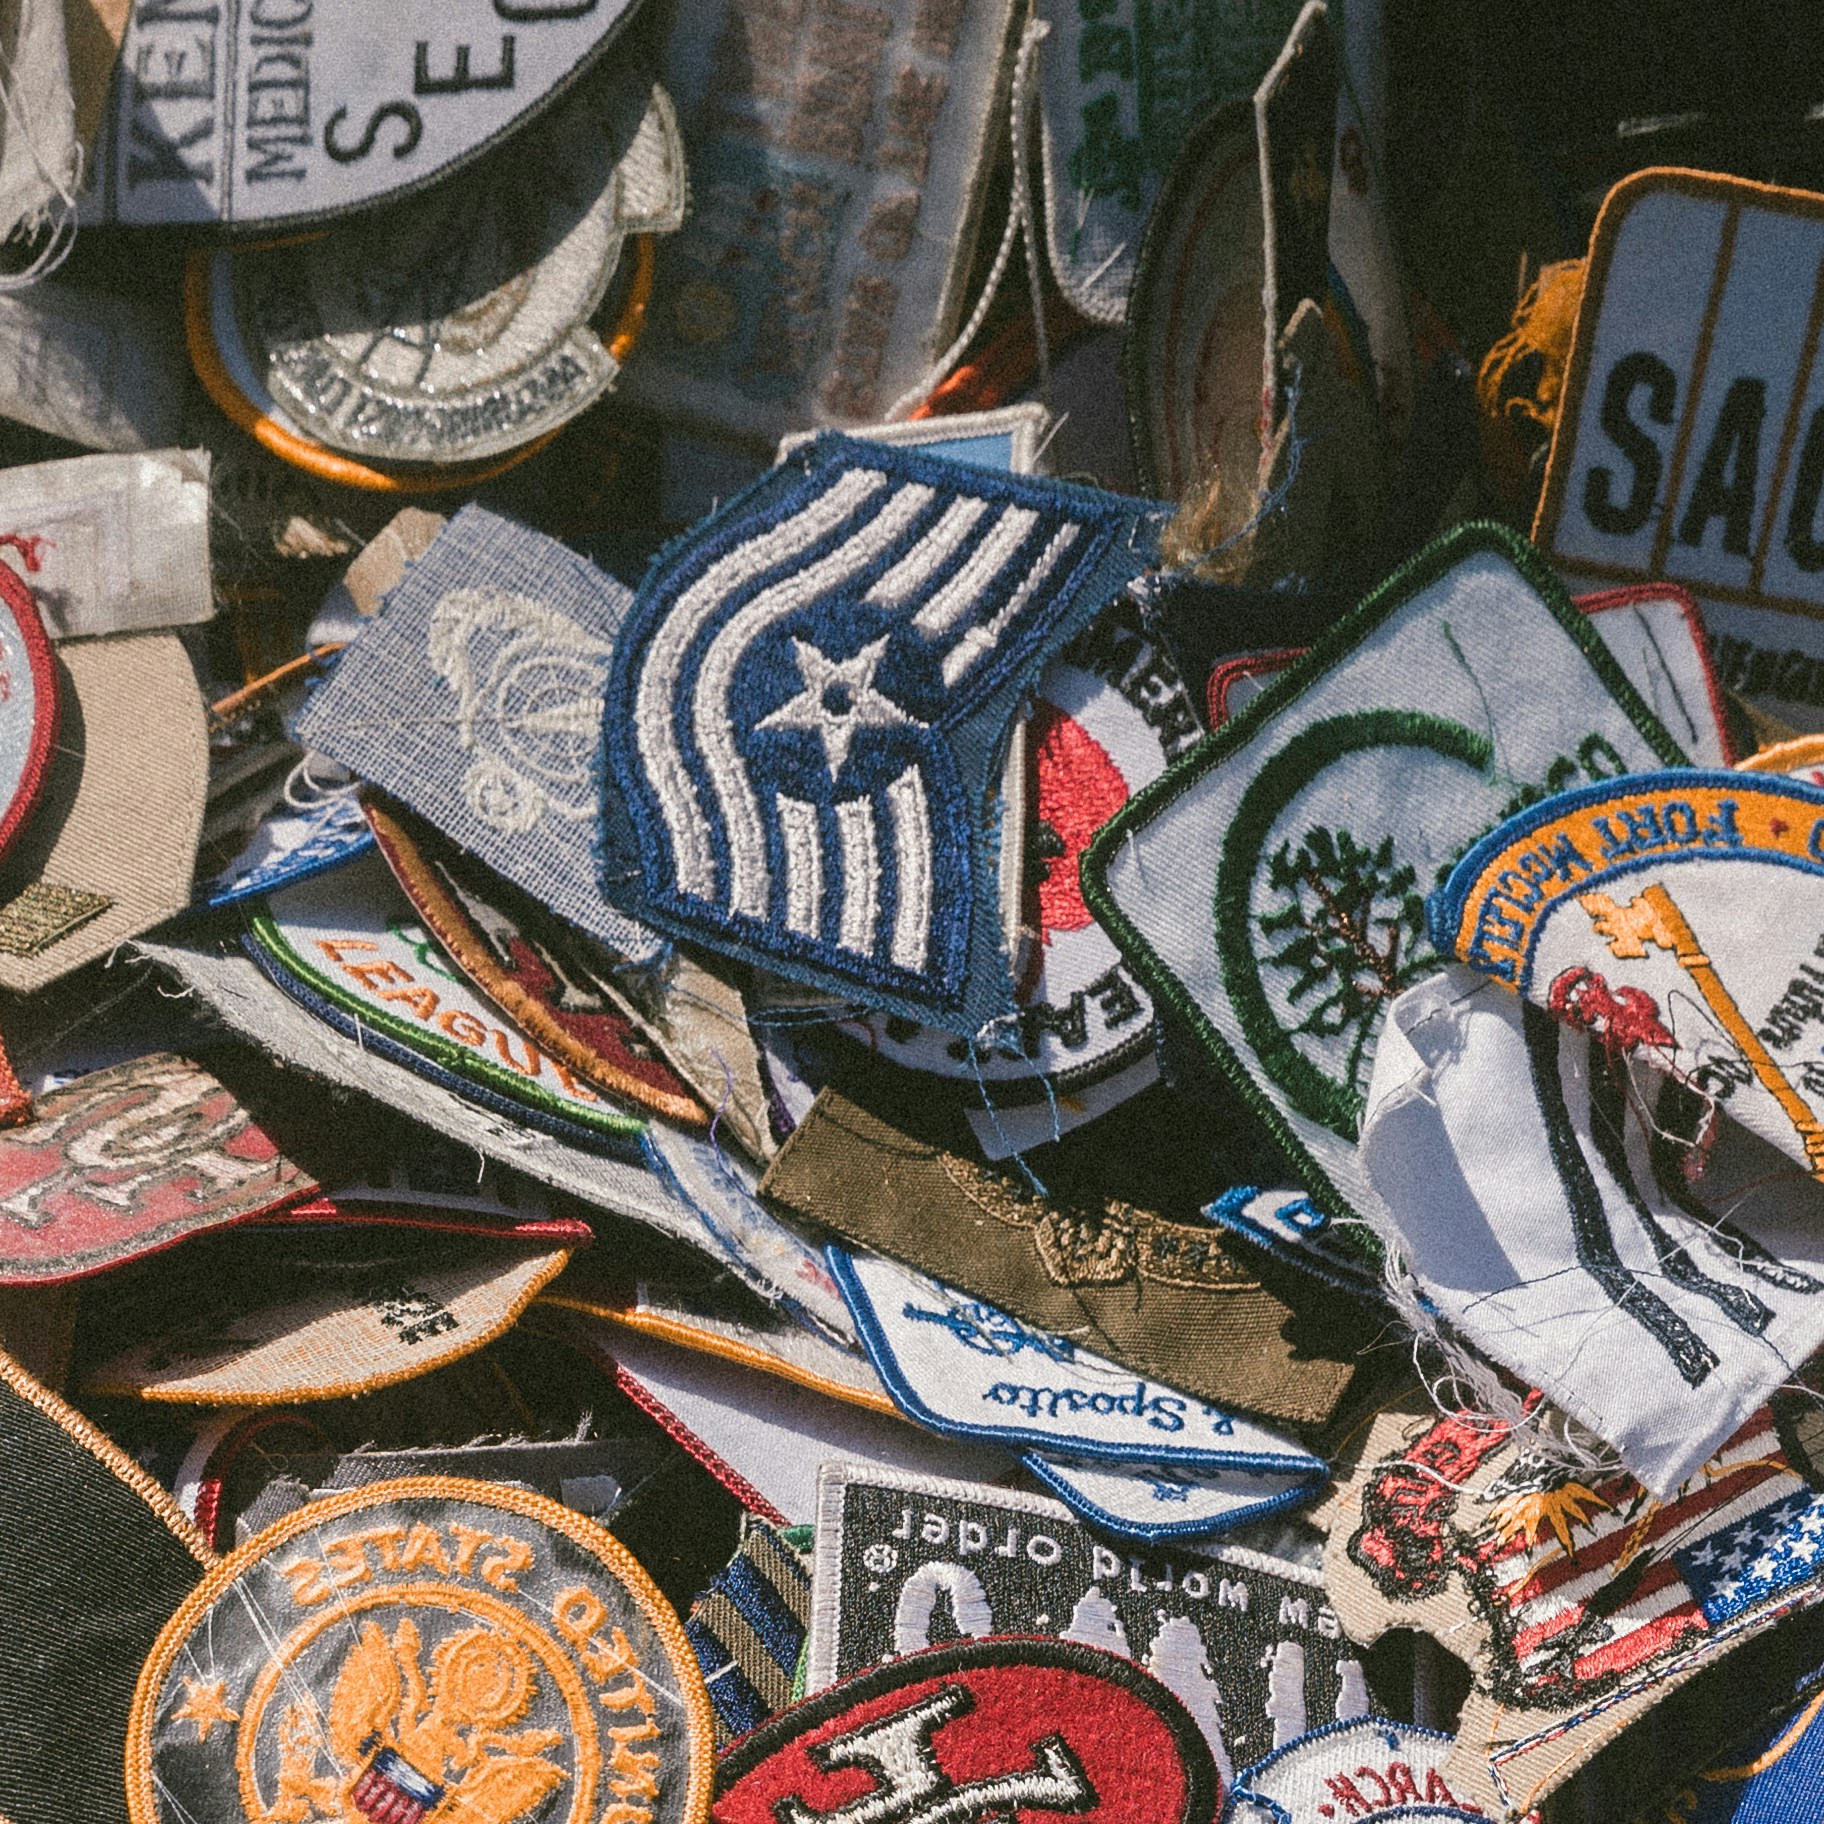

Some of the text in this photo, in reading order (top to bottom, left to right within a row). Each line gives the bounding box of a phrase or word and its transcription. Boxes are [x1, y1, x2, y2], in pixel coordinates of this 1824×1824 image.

[1590, 800, 1740, 857] FORT
[889, 1504, 1063, 1571] order
[1092, 1544, 1250, 1609] world
